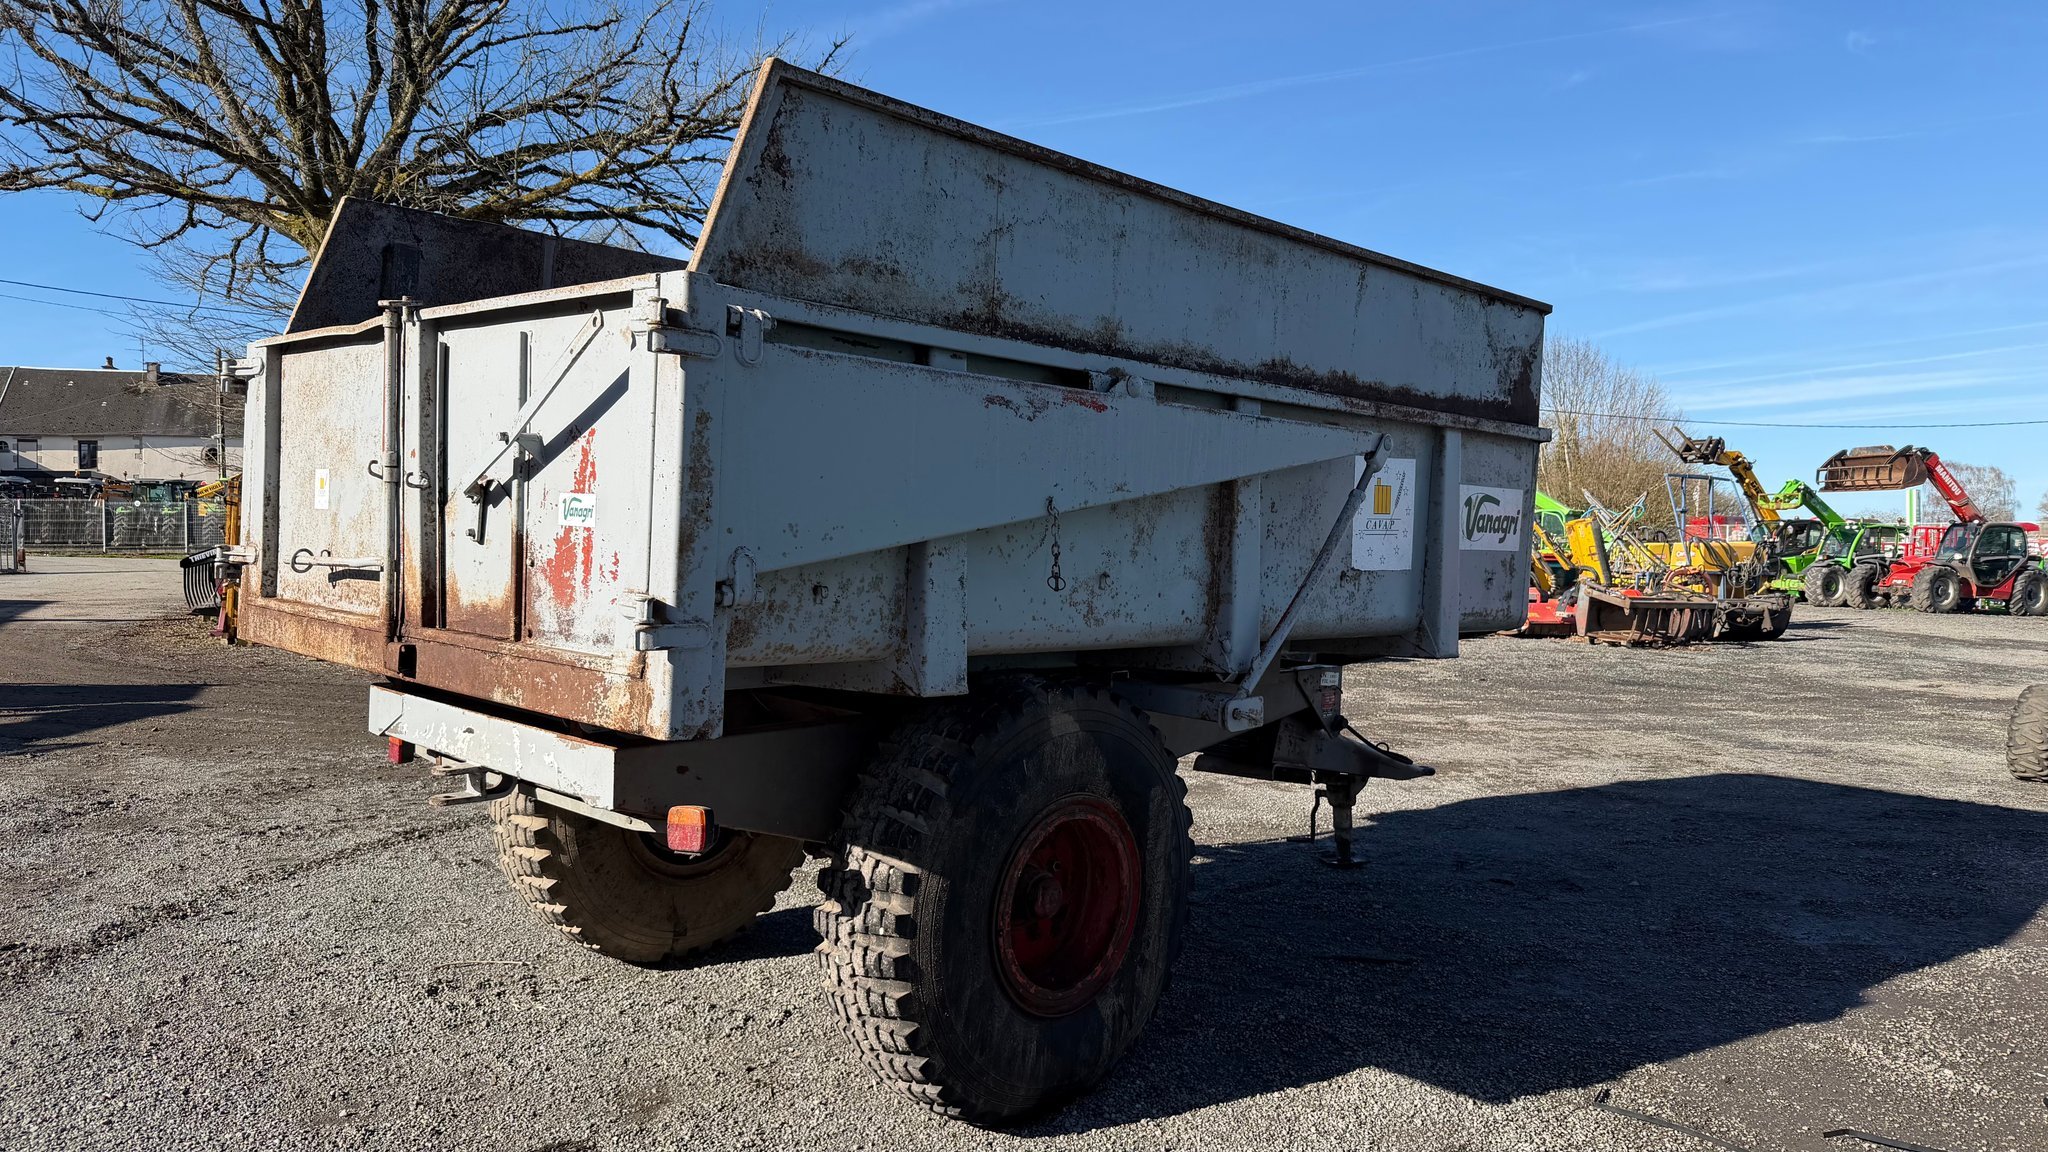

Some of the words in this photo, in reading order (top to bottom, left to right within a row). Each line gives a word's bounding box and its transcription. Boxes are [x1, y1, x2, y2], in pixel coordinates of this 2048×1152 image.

[1935, 464, 1962, 496] MANITOU
[563, 497, 594, 523] Vanagri
[1464, 494, 1520, 544] Vanagri
[1365, 520, 1395, 530] CAVAP
